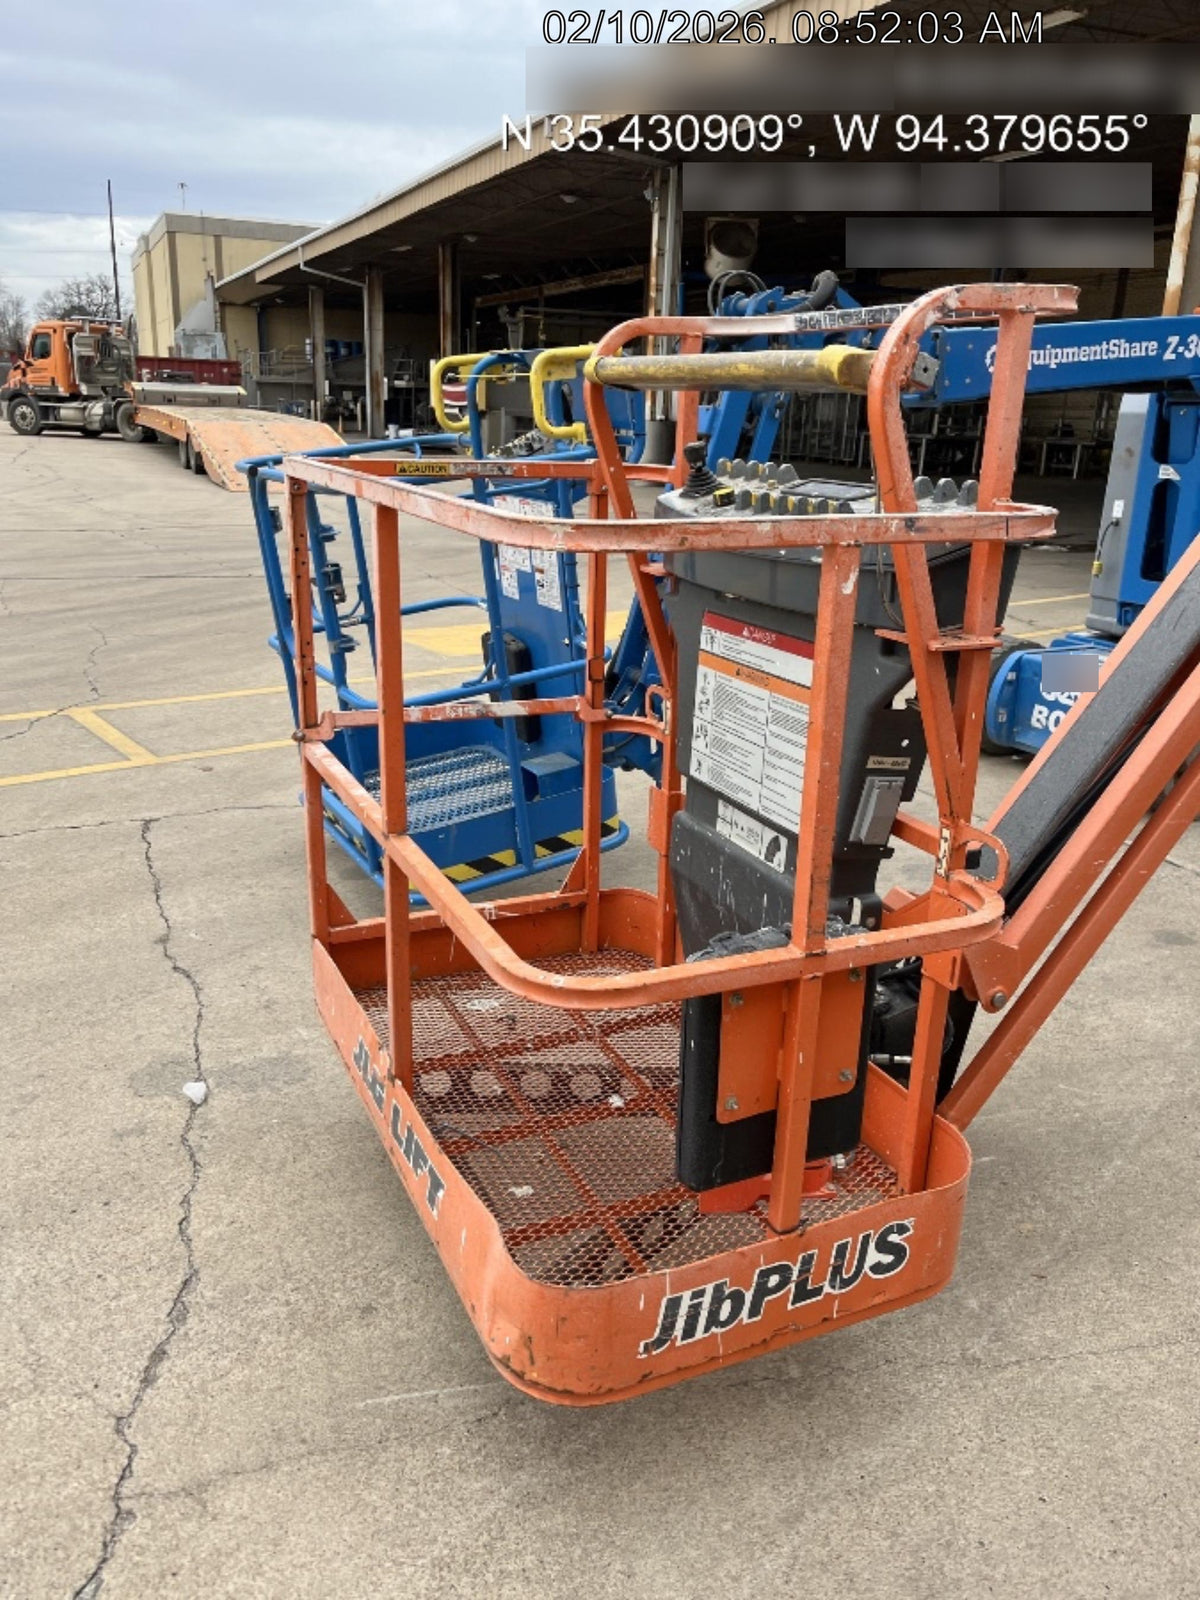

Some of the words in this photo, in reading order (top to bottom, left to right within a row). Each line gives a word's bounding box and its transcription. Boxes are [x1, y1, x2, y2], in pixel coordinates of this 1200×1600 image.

[1030, 703, 1066, 733] BO
[389, 1099, 447, 1221] LIFT
[636, 1217, 916, 1359] JibPLUS
